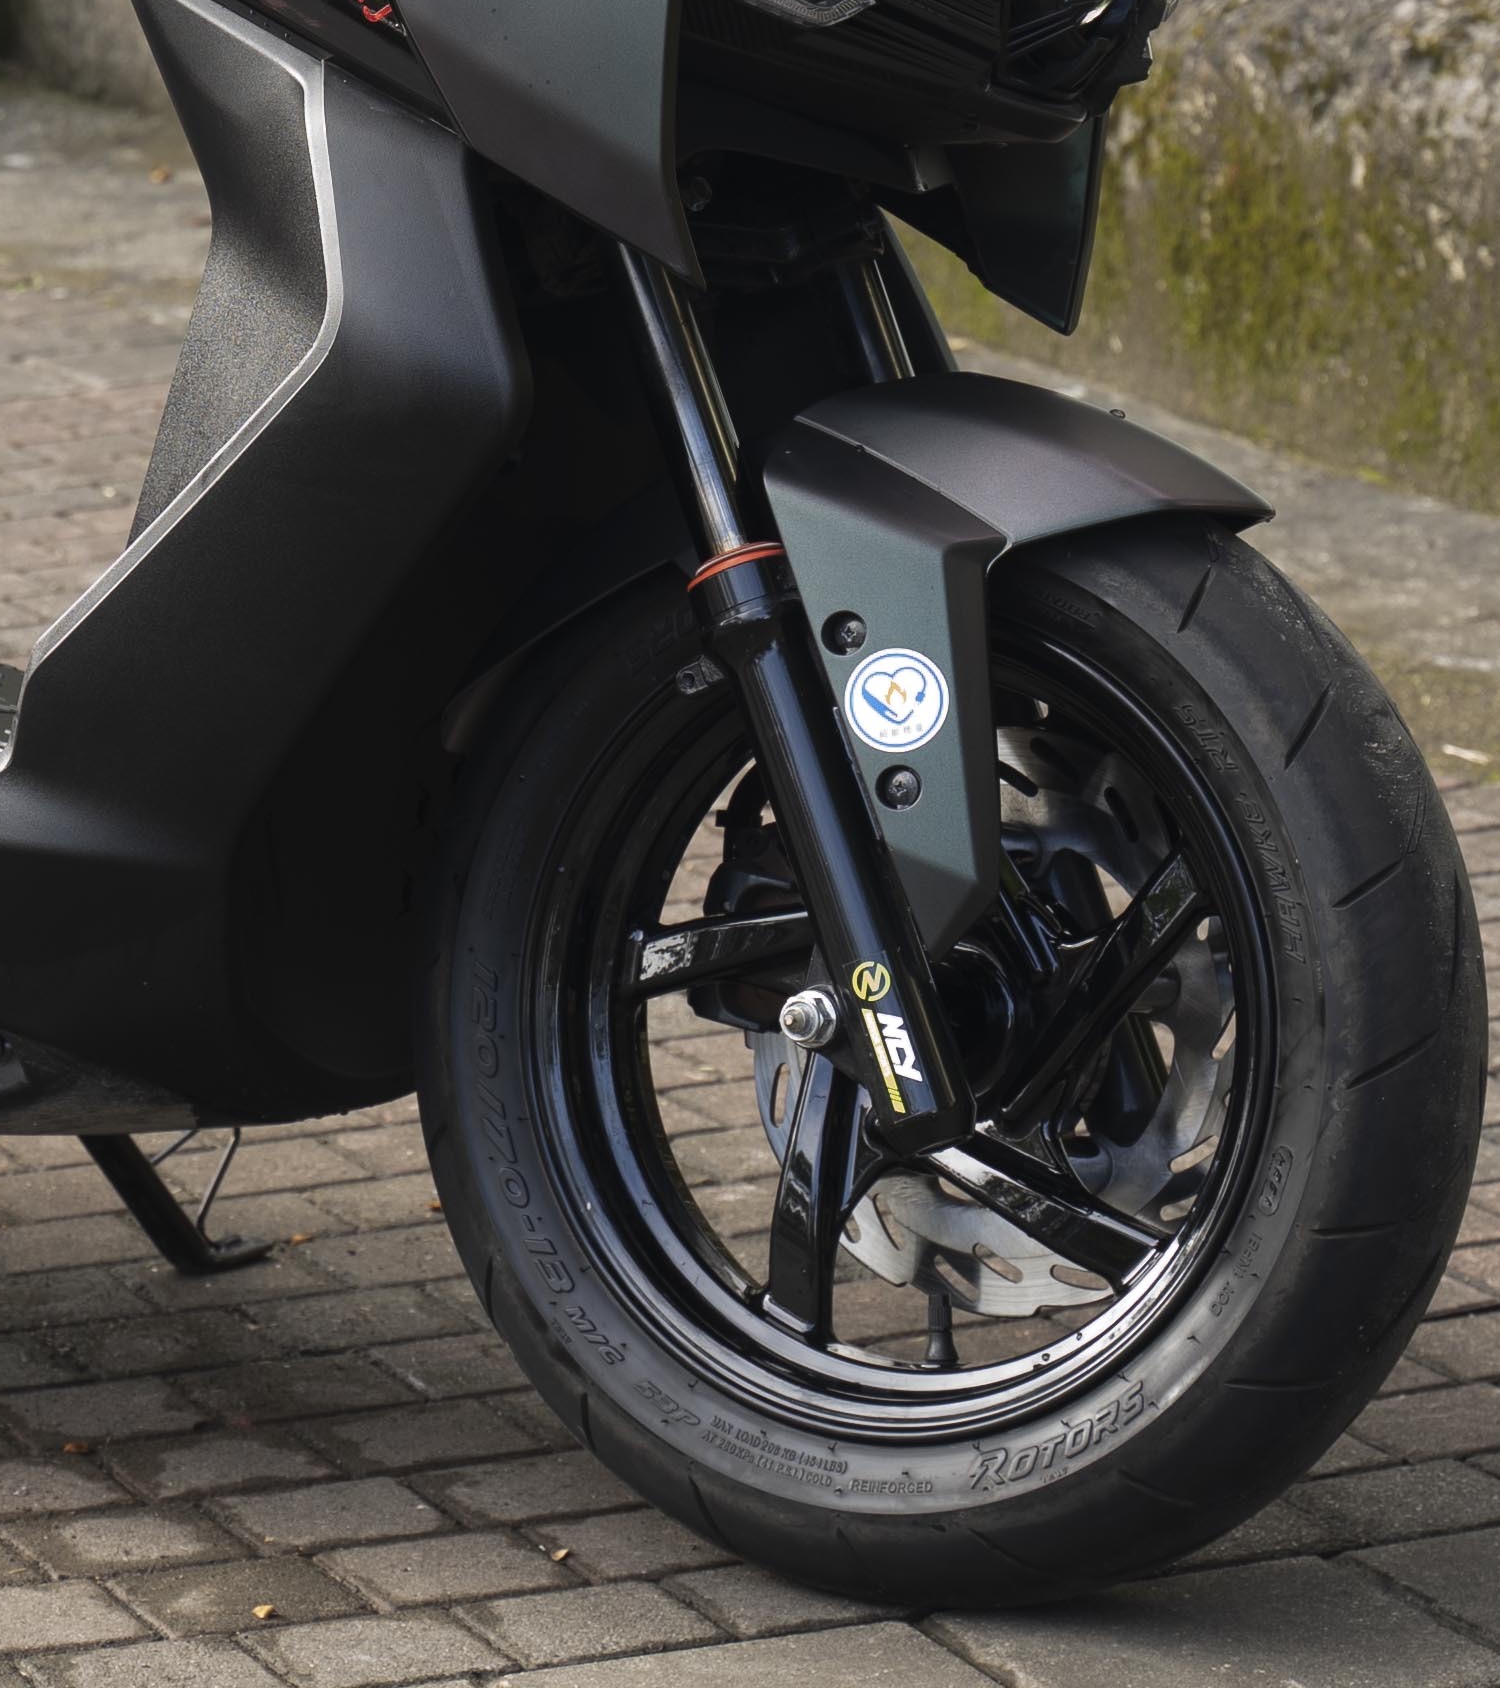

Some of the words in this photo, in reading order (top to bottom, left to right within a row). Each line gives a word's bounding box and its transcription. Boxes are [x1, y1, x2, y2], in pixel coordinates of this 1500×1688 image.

[877, 1013, 924, 1084] NCY
[471, 960, 578, 1296] 120/70-13
[564, 1304, 626, 1367] M/C
[967, 1378, 1145, 1490] ROTORS
[848, 1478, 935, 1497] REINFORCED
